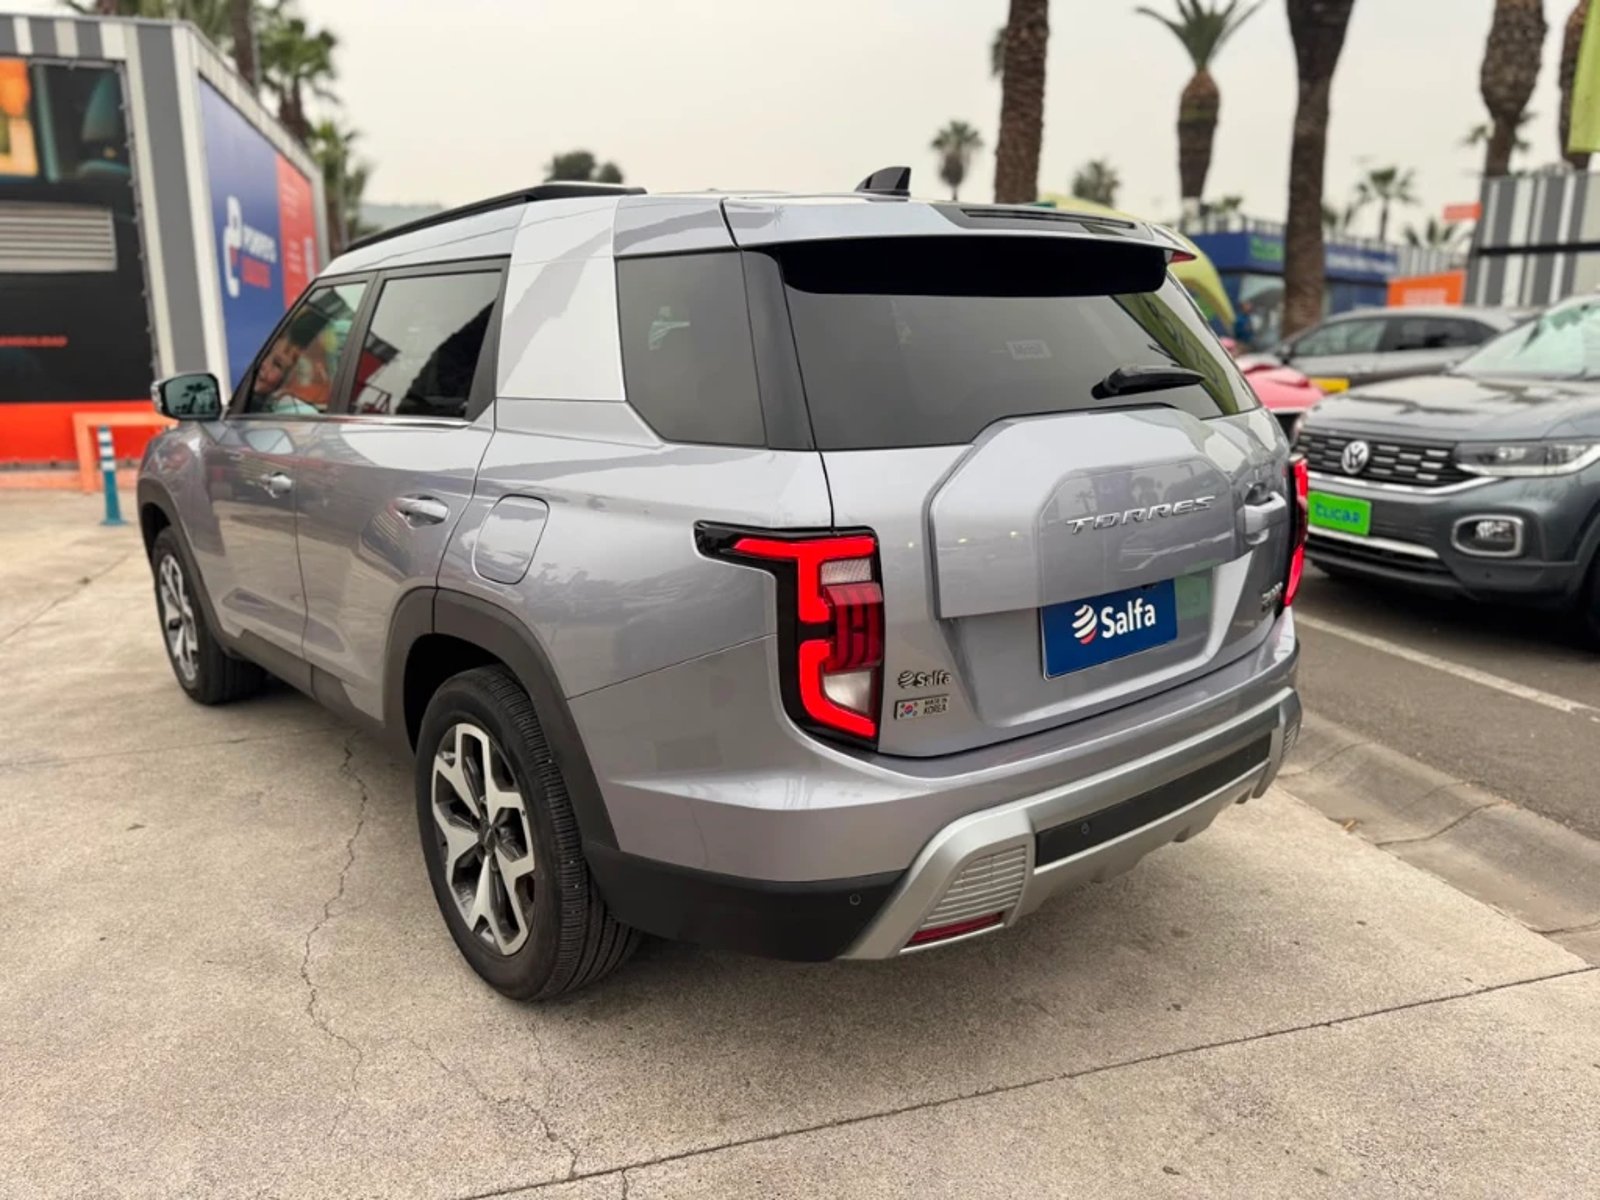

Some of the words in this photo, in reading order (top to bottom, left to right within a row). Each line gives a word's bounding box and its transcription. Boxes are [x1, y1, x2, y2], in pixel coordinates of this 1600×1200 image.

[1066, 495, 1215, 535] TORRES
[1101, 598, 1156, 639] Salfa
[913, 669, 952, 687] Salfa
[923, 703, 947, 714] KOREA
